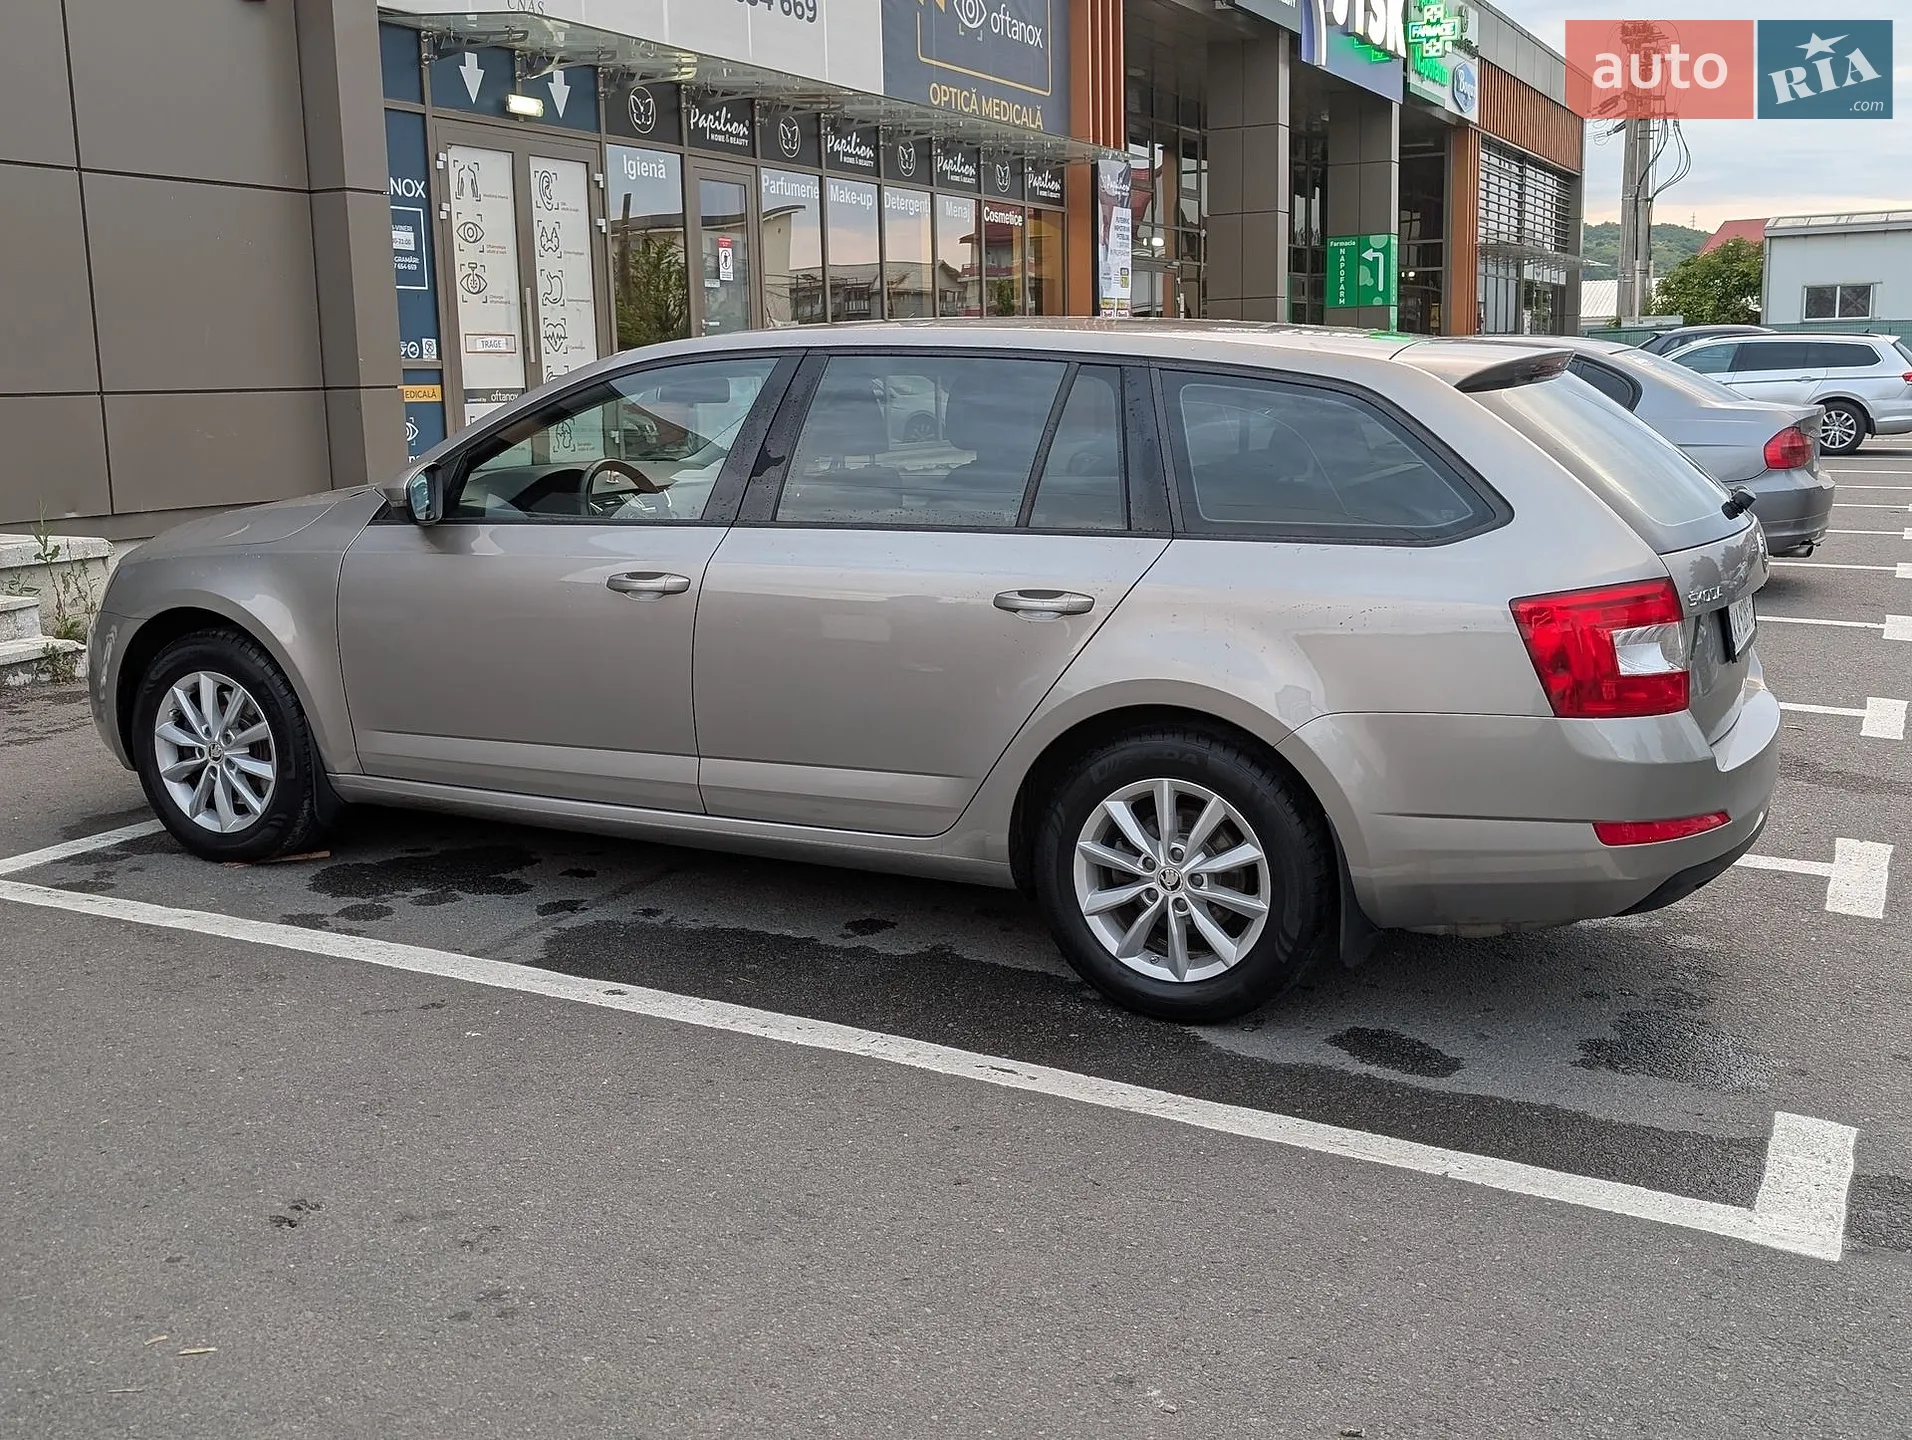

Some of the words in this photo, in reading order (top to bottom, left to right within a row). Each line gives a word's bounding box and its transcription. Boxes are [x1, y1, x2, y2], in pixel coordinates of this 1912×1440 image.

[990, 3, 1043, 49] oftanox
[929, 82, 979, 115] OPTICĂ
[981, 95, 1044, 131] MEDICALĂ
[690, 106, 749, 140] Papilion
[827, 131, 874, 162] Papilion
[623, 154, 667, 180] Igienă
[937, 153, 976, 180] Papilion
[390, 177, 426, 199] NOX
[761, 174, 819, 200] Parfumerie
[830, 184, 873, 211] Make-up
[945, 200, 971, 223] Menaj
[983, 206, 1023, 227] Cosmetice
[1338, 248, 1346, 305] NAPOFARM
[481, 340, 503, 350] TRAGE
[405, 388, 437, 400] EDICALĂ
